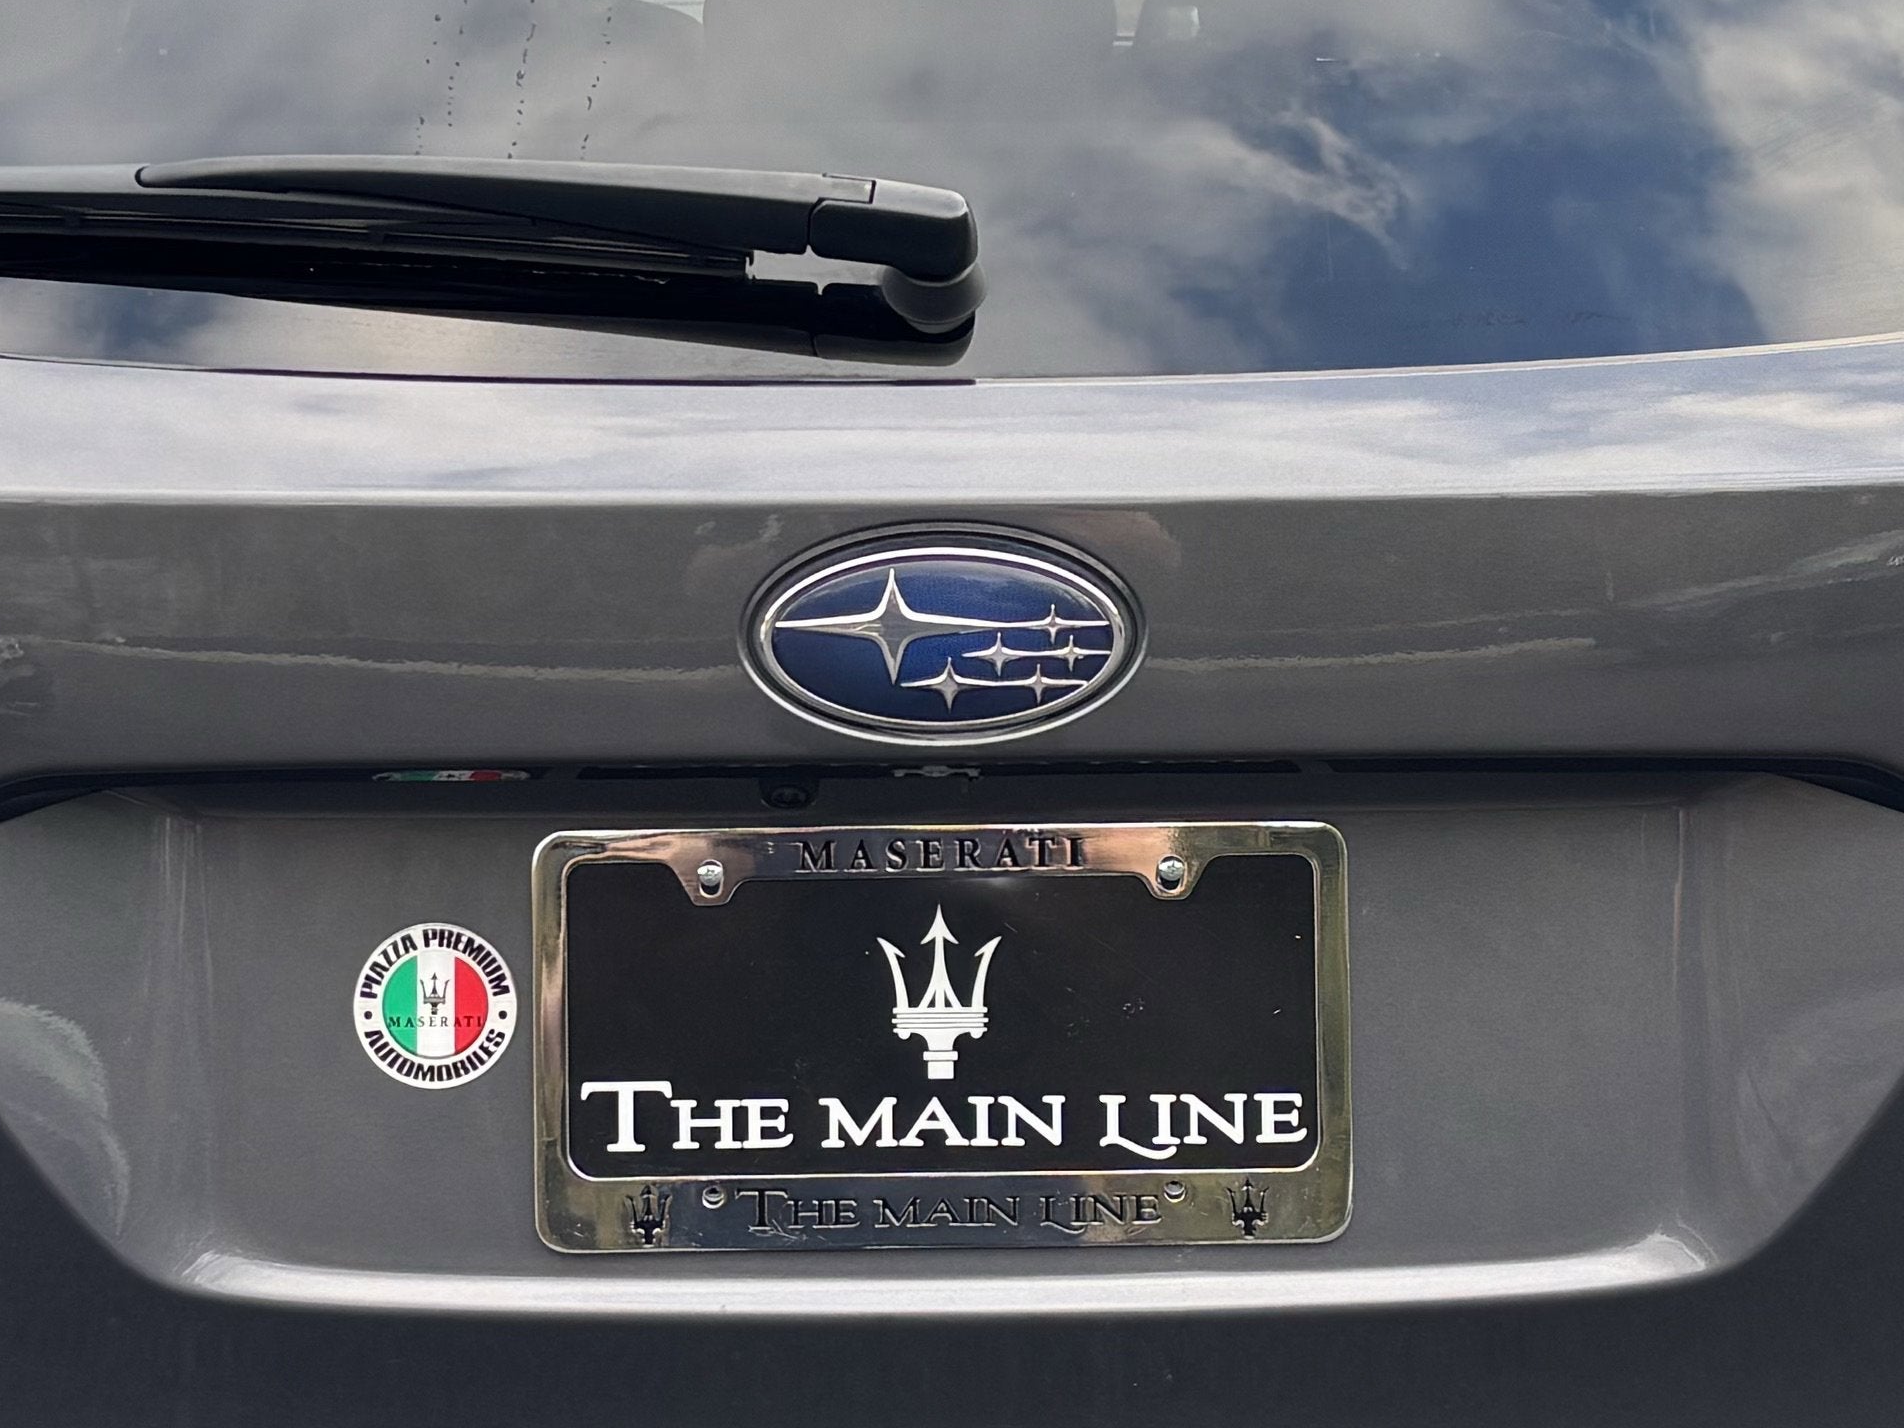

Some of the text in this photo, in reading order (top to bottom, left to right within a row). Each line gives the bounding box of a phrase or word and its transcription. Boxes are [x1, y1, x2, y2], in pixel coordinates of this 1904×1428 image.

[795, 835, 1084, 872] MASERATI
[360, 928, 511, 999] PIAZZA PREMIUM
[388, 1015, 482, 1028] MASERATI
[364, 1028, 506, 1082] AUTOMOBILES
[818, 1095, 1066, 1149] MAIN
[1099, 1093, 1308, 1159] LINE
[874, 1195, 1020, 1229] MAIN
[1039, 1193, 1163, 1234] LINE
